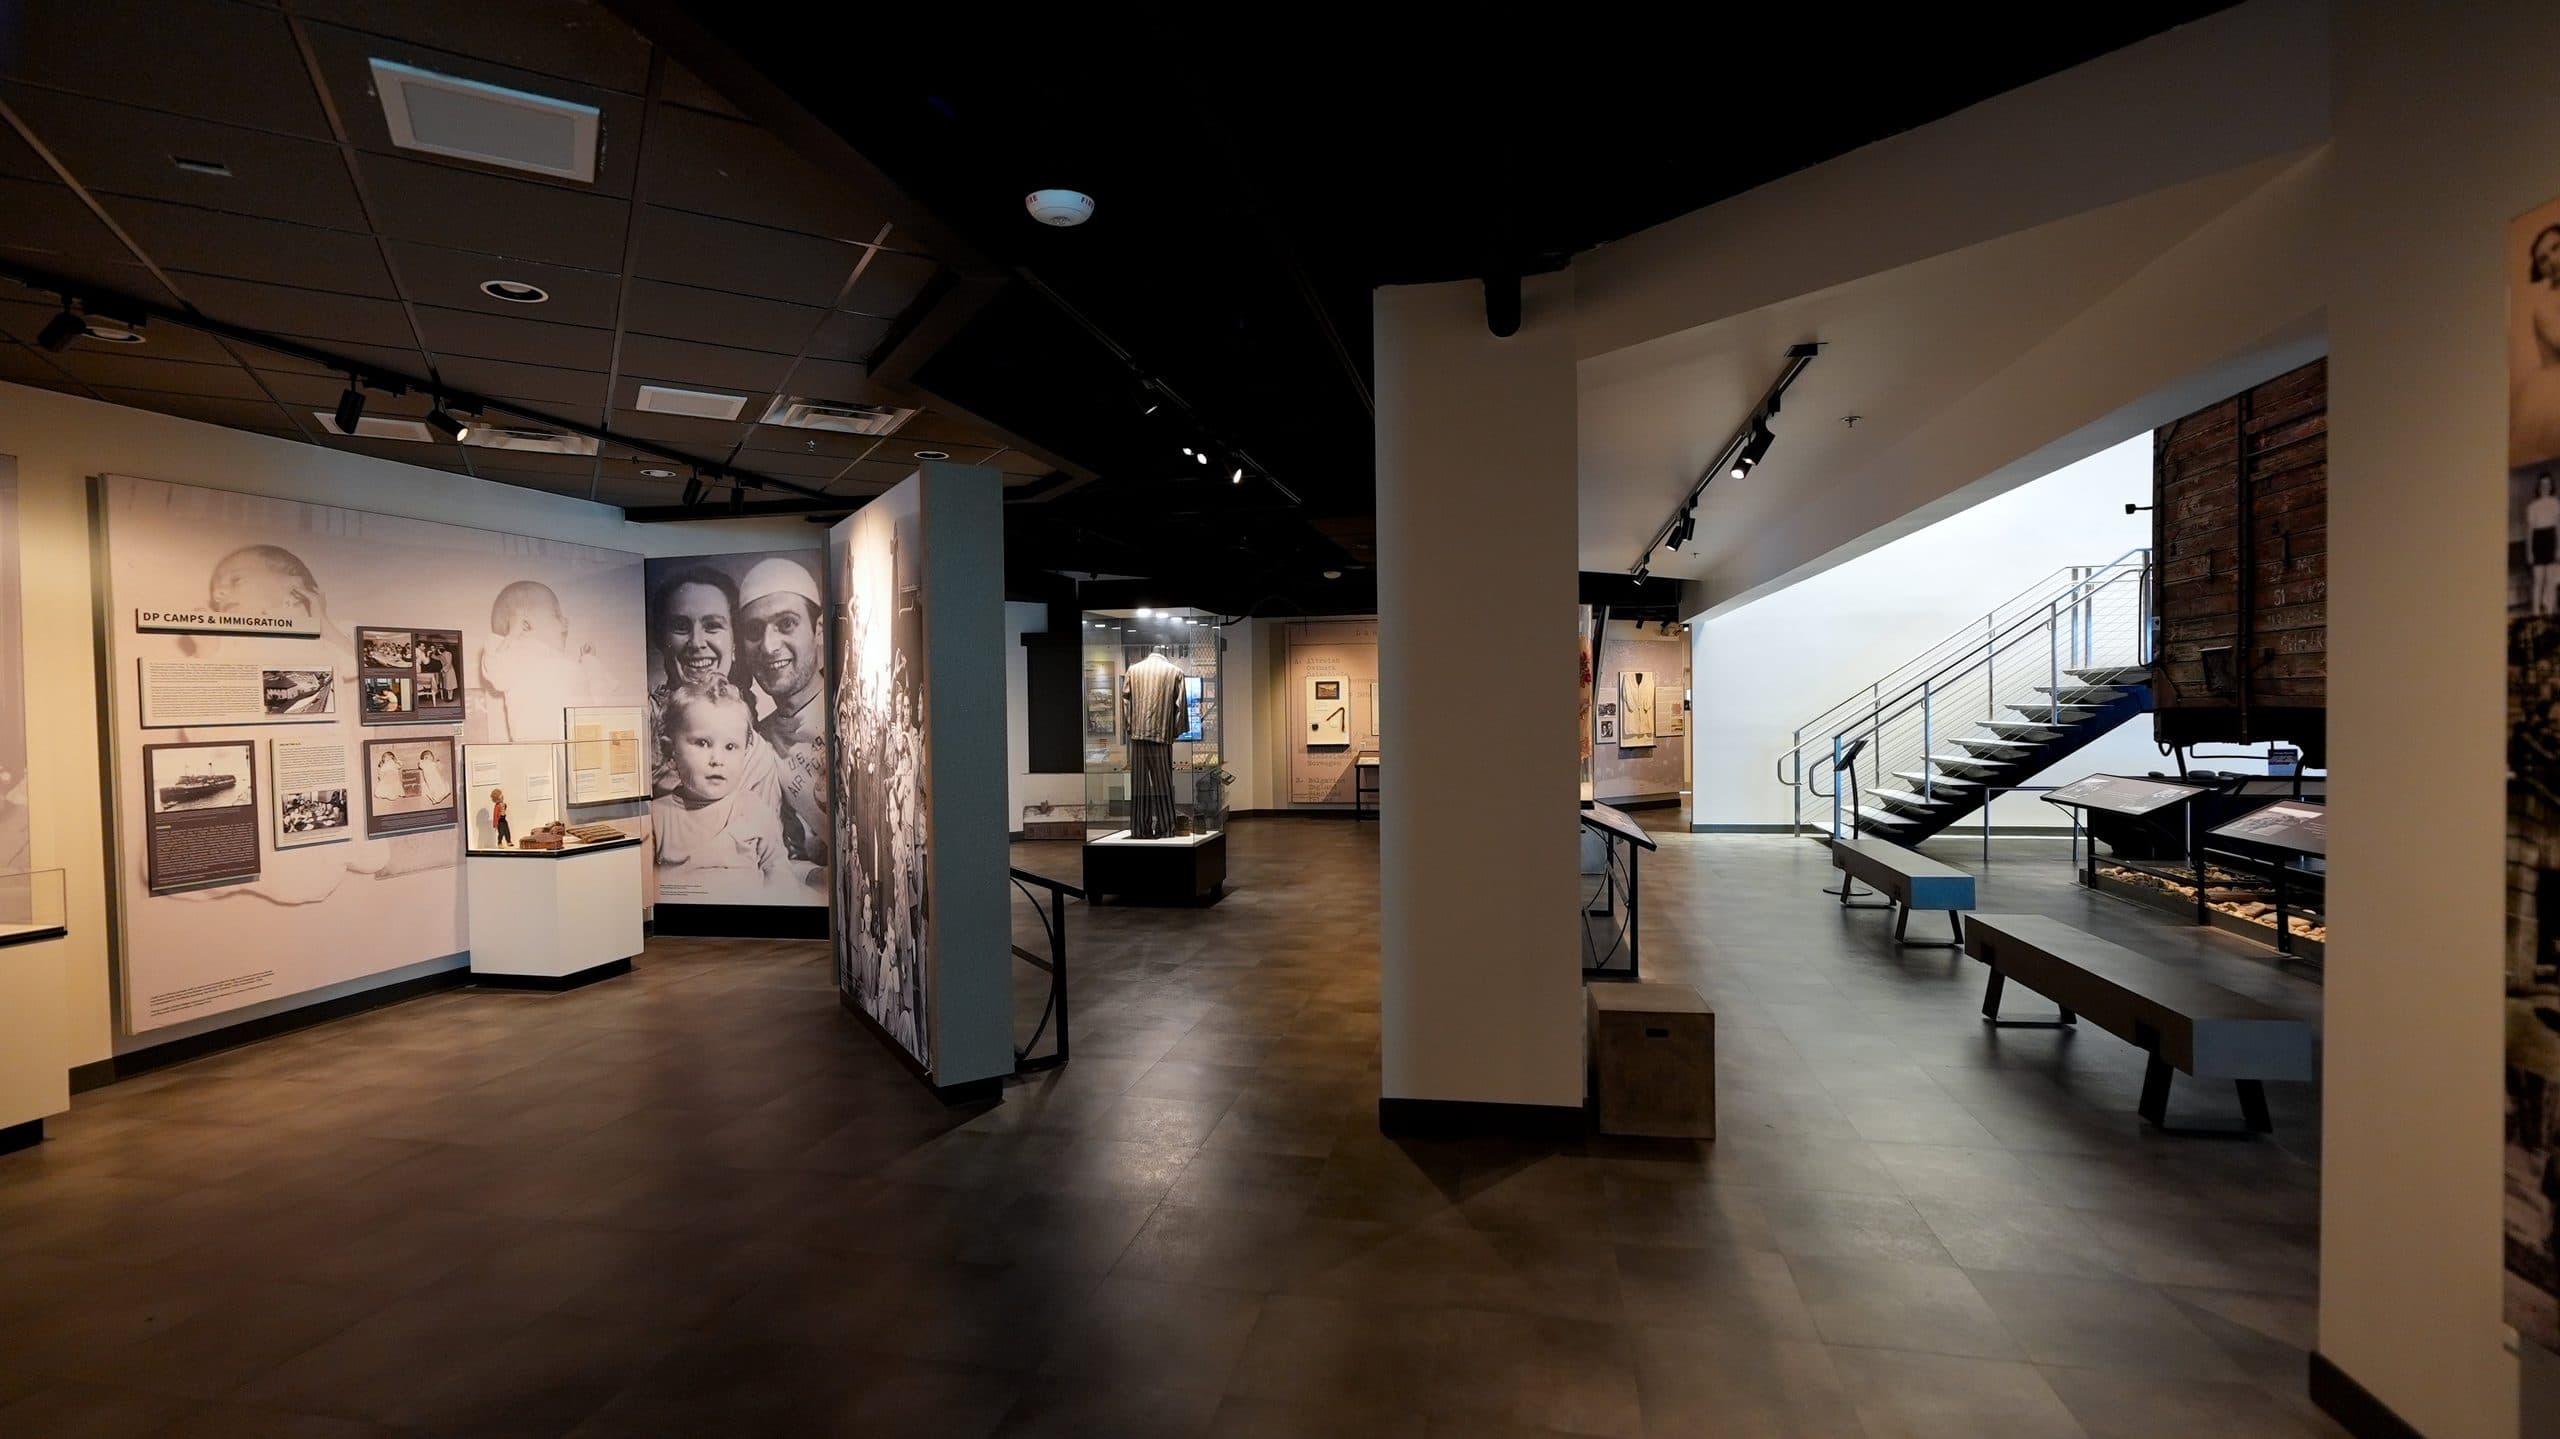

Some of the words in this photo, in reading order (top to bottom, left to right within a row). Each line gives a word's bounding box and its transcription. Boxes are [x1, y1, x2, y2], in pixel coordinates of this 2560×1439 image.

[143, 612, 160, 621] DP
[163, 613, 205, 624] CAMPS
[207, 615, 216, 624] &
[219, 616, 293, 628] IMMIGRATION
[788, 775, 806, 798] AIR
